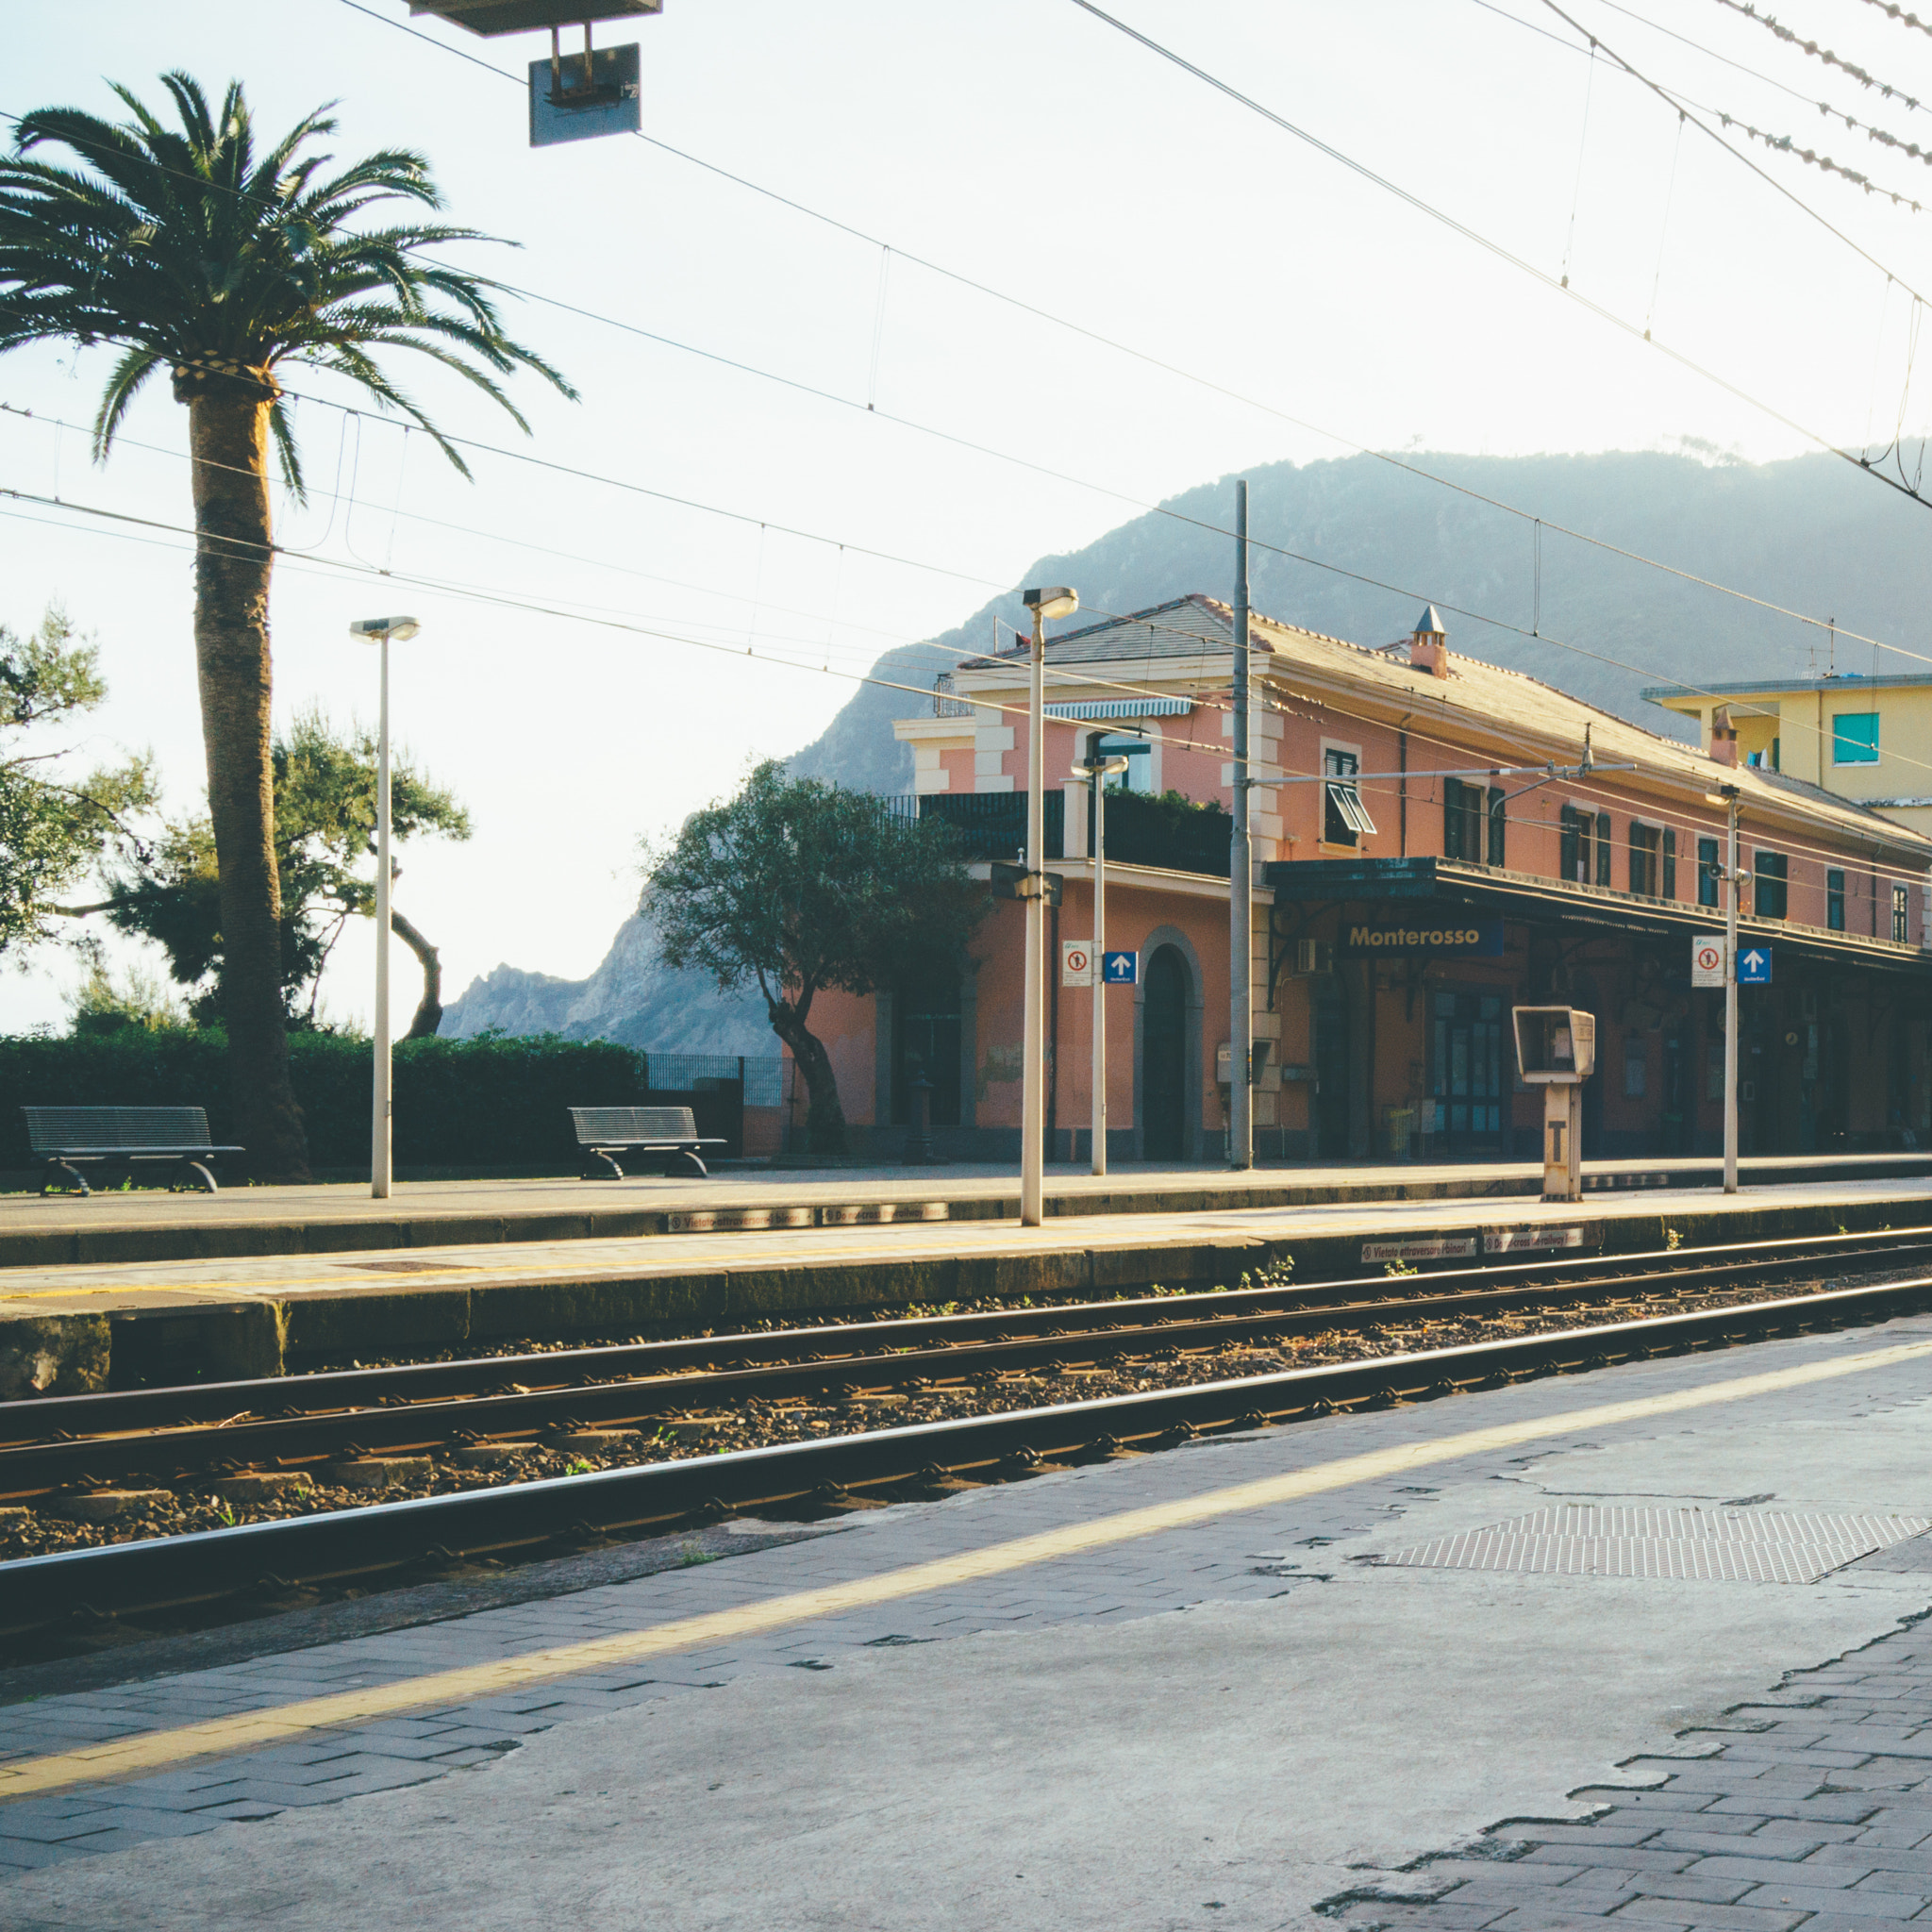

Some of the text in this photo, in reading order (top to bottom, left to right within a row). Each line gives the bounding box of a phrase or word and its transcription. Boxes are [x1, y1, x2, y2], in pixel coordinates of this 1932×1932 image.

[1349, 926, 1479, 946] Monterosso
[1548, 1121, 1567, 1162] T
[684, 1217, 714, 1228] Vietato
[775, 1212, 800, 1224] binari
[836, 1210, 847, 1221] Do
[1374, 1246, 1397, 1257] Vietato
[1400, 1245, 1441, 1256] attraversare
[1445, 1242, 1466, 1254] binari
[1513, 1238, 1530, 1247] cross
